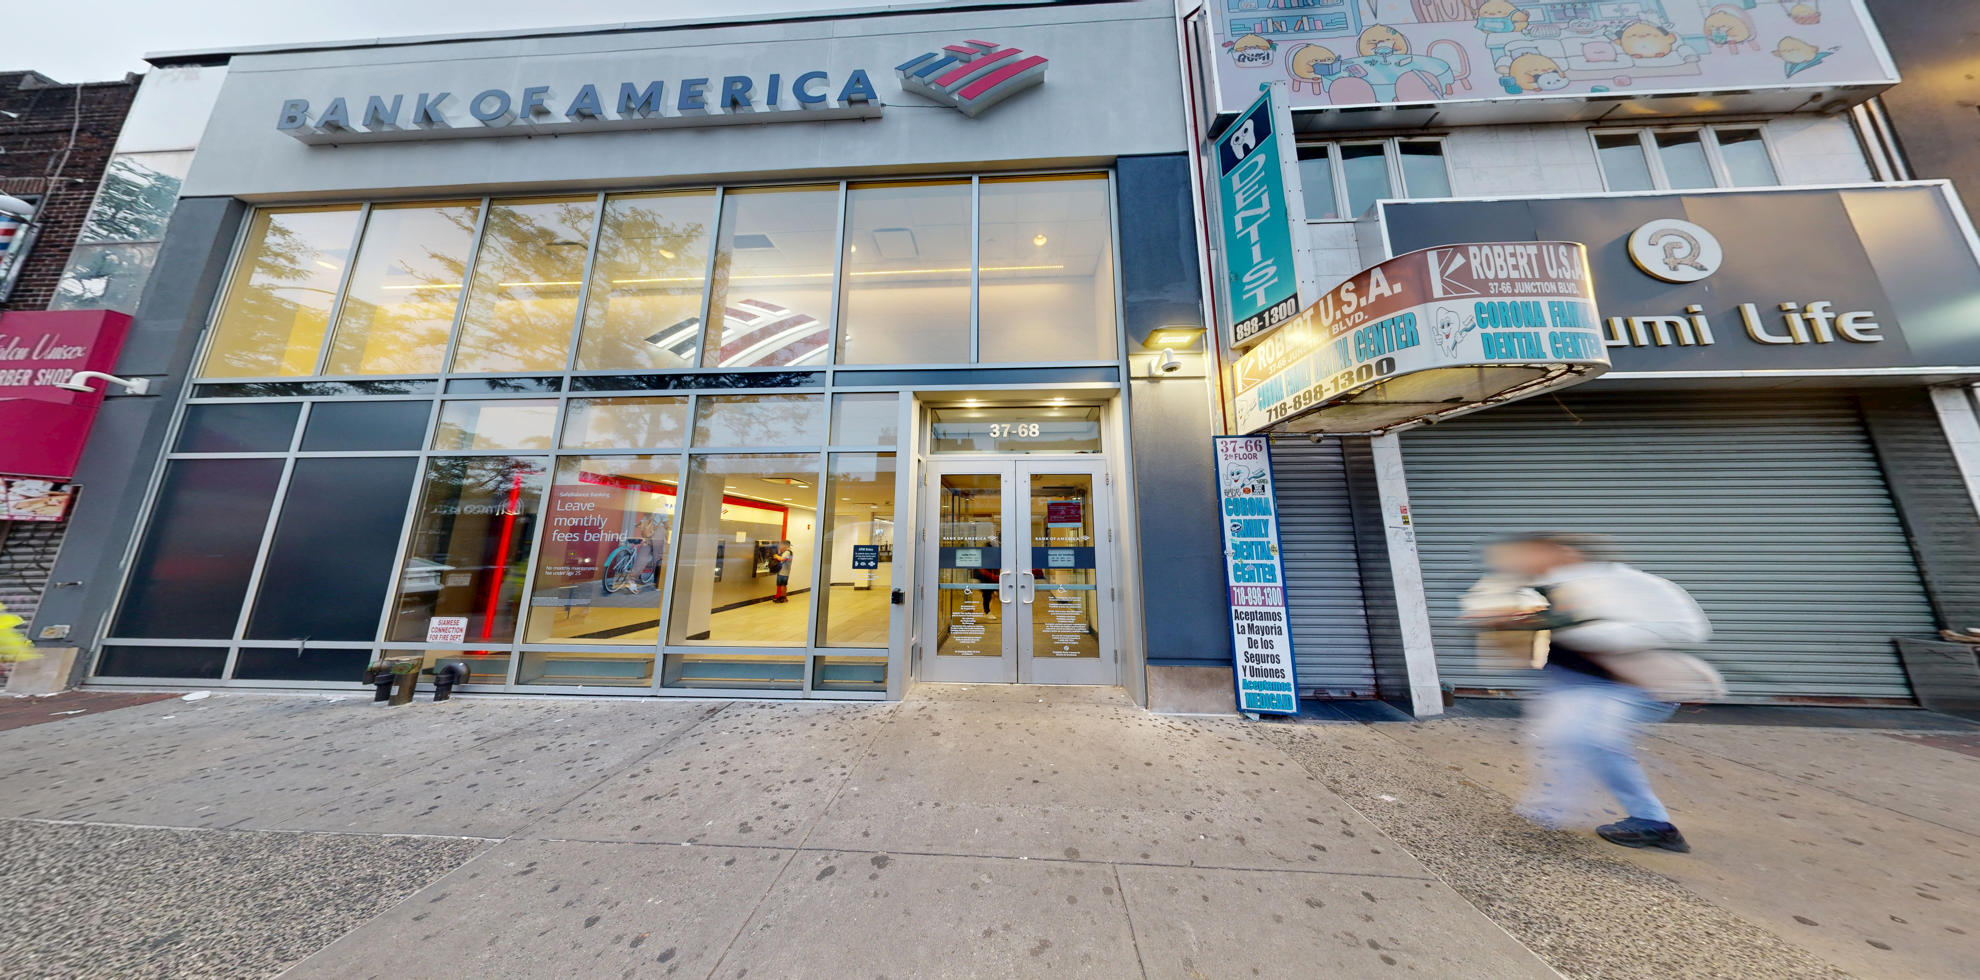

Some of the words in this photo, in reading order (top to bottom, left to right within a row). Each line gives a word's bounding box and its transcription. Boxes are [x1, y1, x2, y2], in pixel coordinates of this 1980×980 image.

[277, 93, 450, 130] BANK
[469, 86, 550, 121] OF
[566, 69, 878, 117] AMERICA
[1232, 153, 1278, 307] DENTIST
[1468, 245, 1540, 280] ROBERT
[1318, 266, 1403, 327] U.S.A.
[1489, 282, 1512, 294] 37-66
[1513, 282, 1557, 294] JUNCTION
[1236, 298, 1296, 343] 898-1300
[1332, 311, 1368, 334] BLVD.
[1474, 301, 1547, 329] CORONA
[1739, 300, 1884, 345] Life
[1354, 311, 1420, 364] CENTER
[1481, 332, 1547, 360] DENTAL
[34, 369, 73, 386] SHOP
[1266, 357, 1396, 422] 718-898-1300
[989, 423, 1040, 438] 37-68
[1220, 440, 1263, 453] 37-66
[557, 500, 595, 511] Leave
[1225, 497, 1272, 516] CORONA
[554, 514, 608, 529] monthly
[552, 530, 579, 542] fees
[584, 530, 628, 542] behind
[1233, 563, 1277, 583] CENTER
[1233, 587, 1282, 606] 718-898-1300
[1234, 609, 1282, 622] Aceptamos
[1236, 623, 1246, 634] La
[1247, 623, 1282, 636] Mayoria
[1248, 637, 1258, 649] De
[1261, 638, 1274, 649] los
[1244, 651, 1280, 665] Seguros
[1242, 665, 1247, 677] Y
[1249, 666, 1285, 679] Uniones
[1242, 679, 1292, 692] Aceptamos
[1245, 693, 1293, 710] MEDICAID
